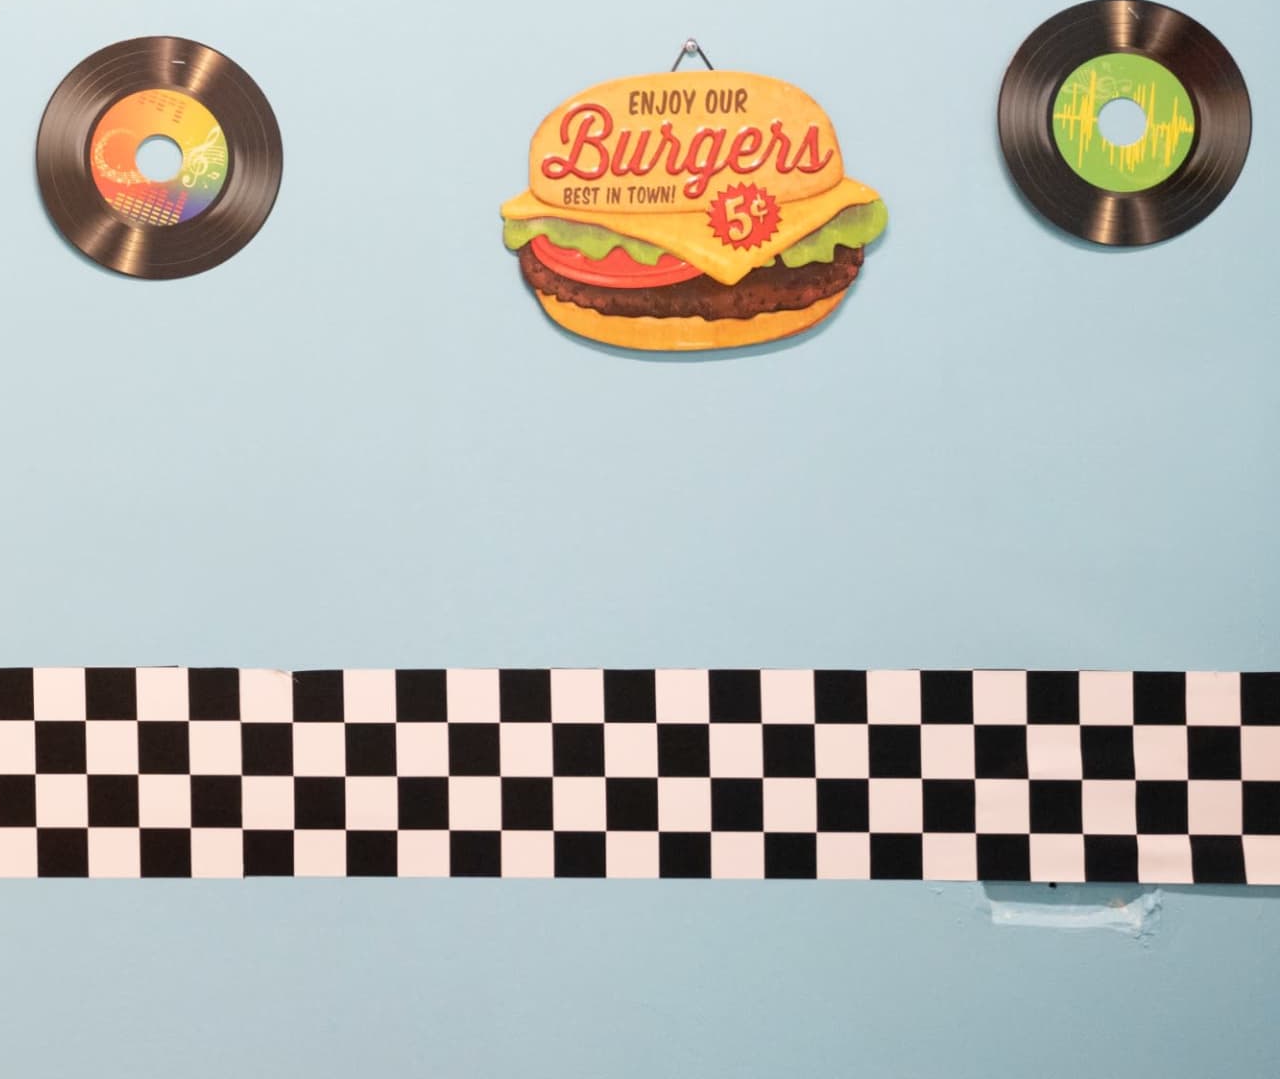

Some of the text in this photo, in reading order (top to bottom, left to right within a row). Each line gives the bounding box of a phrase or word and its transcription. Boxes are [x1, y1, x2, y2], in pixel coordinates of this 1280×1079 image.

[628, 88, 748, 116] ENJOY OUR
[542, 103, 834, 199] Burgers
[563, 185, 676, 205] BEST IN TOWN!
[725, 193, 768, 241] 5¢
